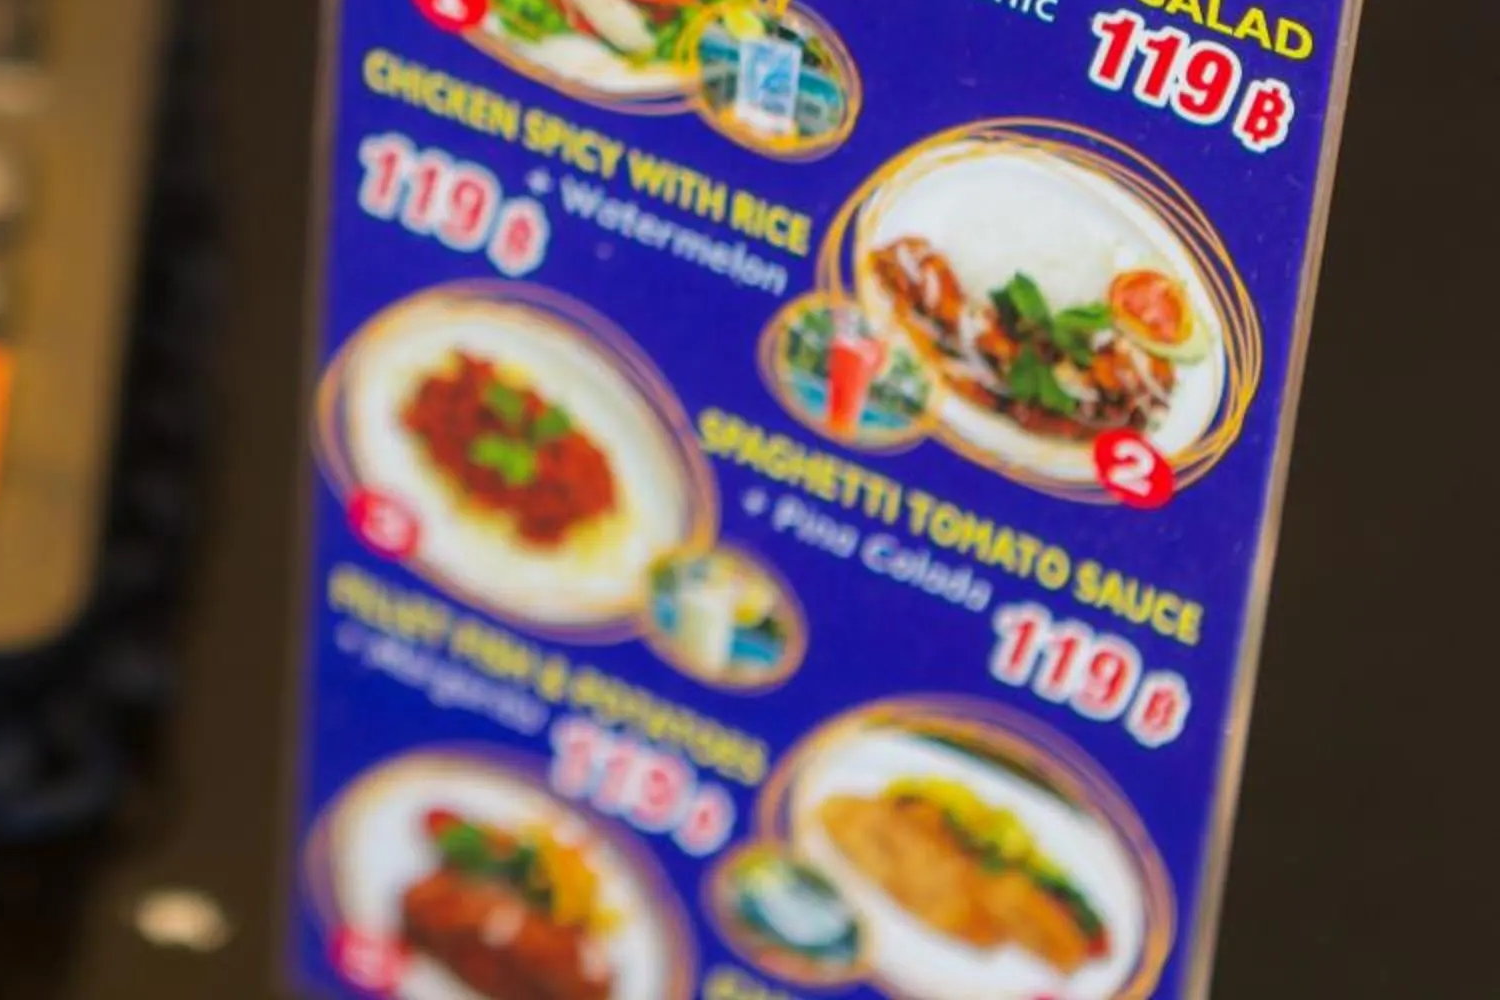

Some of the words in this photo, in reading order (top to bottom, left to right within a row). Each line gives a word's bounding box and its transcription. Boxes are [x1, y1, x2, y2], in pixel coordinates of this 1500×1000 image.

[1092, 12, 1240, 122] 119
[360, 134, 499, 252] 119
[363, 47, 520, 143] CHICKEN
[523, 110, 623, 180] SPICY
[628, 150, 726, 222] WITH
[730, 190, 812, 256] RICE
[560, 176, 788, 296] Watermelon
[699, 408, 900, 524] SPAGHETTI
[907, 491, 1070, 590] TOMATO
[1075, 559, 1203, 645] SAUCE
[1108, 439, 1156, 497] 2
[861, 533, 992, 612] Colada
[989, 602, 1141, 721] 119
